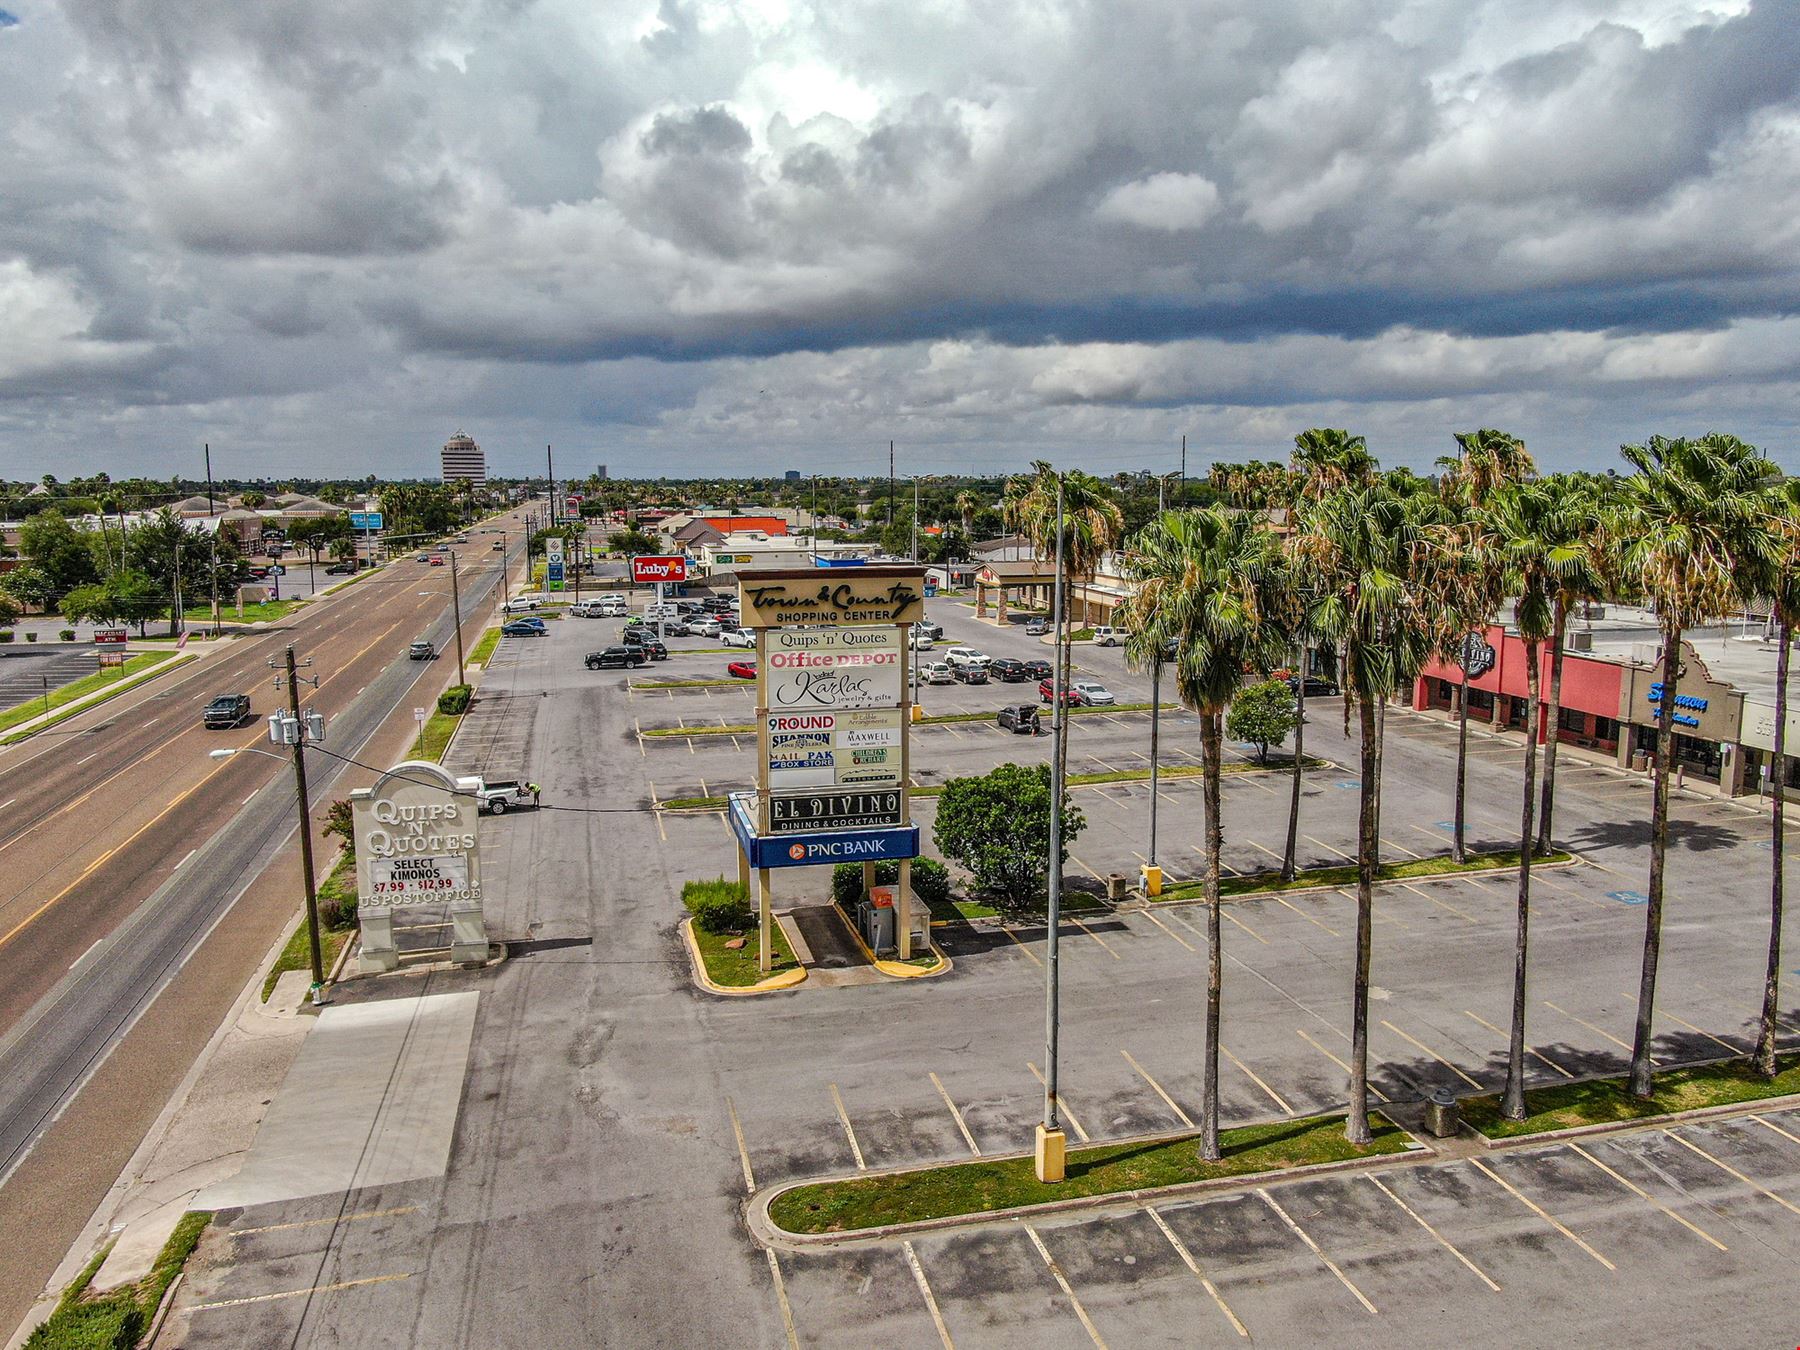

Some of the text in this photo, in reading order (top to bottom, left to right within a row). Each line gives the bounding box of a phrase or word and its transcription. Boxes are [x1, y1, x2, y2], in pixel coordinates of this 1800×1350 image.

[636, 562, 683, 577] Luby's
[744, 586, 819, 609] Town
[817, 585, 830, 602] &
[776, 611, 890, 622] SHOPPING CENTER
[780, 633, 818, 647] Quips
[842, 631, 887, 645] Quotes
[770, 652, 897, 668] Office DEPOT
[837, 695, 866, 703] jewelry
[874, 693, 891, 702] gifts
[768, 716, 834, 731] 9ROUND
[848, 718, 888, 727] Arrangements
[858, 713, 877, 721] Edible
[772, 732, 831, 749] SHANNON
[847, 733, 890, 742] MAXWELL
[769, 750, 834, 761] MAIL PAK
[371, 799, 457, 825] QUIPS
[774, 794, 897, 818] EL DIVINO
[781, 816, 891, 830] DINING & COCKTAILS
[367, 831, 475, 857] QUOTES
[807, 839, 886, 857] PNC BANK
[394, 858, 434, 870] SELECT
[390, 868, 440, 881] KIMONOS
[374, 881, 405, 893] $7.99
[418, 878, 453, 891] $12.99
[359, 888, 482, 908] US POST OFFICE
